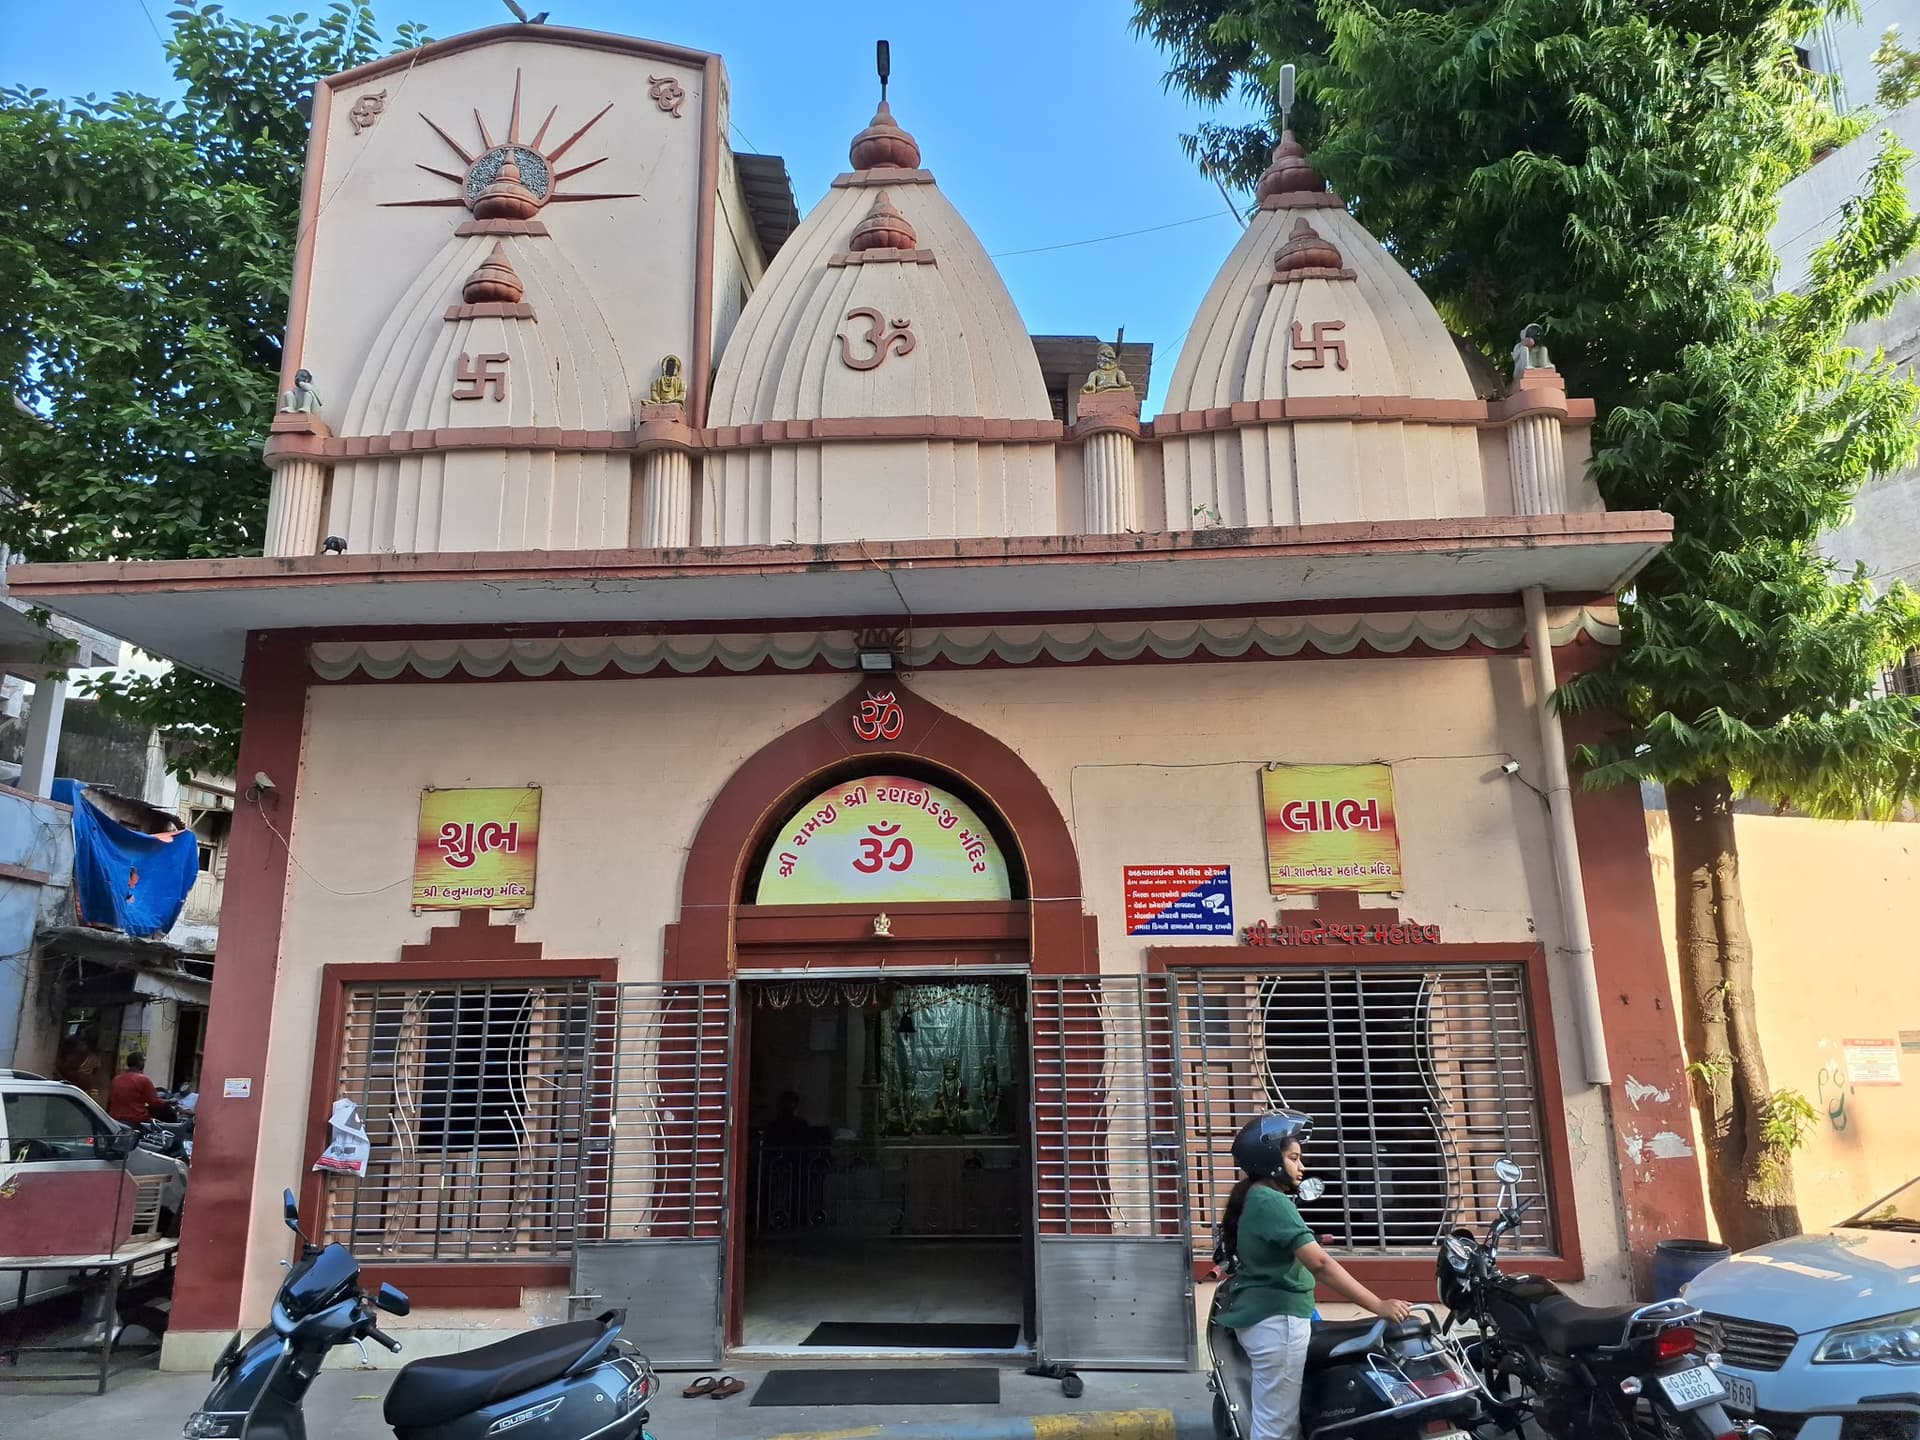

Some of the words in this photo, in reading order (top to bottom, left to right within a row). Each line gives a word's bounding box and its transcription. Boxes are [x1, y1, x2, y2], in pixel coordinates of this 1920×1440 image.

[1281, 799, 1379, 831] લાભ
[780, 852, 798, 877] શ્રી
[793, 804, 837, 845] રામજી
[844, 787, 867, 806] શ્રી
[877, 789, 959, 829] રણછોડજી
[959, 829, 986, 873] મંદિર
[440, 822, 518, 868] શુભ
[1177, 867, 1200, 876] પોલીસ
[1279, 865, 1290, 877] શ્રી
[1337, 862, 1367, 876] મહાદેવ
[1370, 861, 1392, 875] મંદિર
[424, 886, 437, 897] શ્રી
[442, 887, 494, 900] હનુમાનજી
[500, 882, 526, 896] મંદિર
[1248, 919, 1271, 946] શ્રી
[1372, 917, 1441, 945] મહાદેવ
[1669, 1369, 1702, 1389] GJ05P
